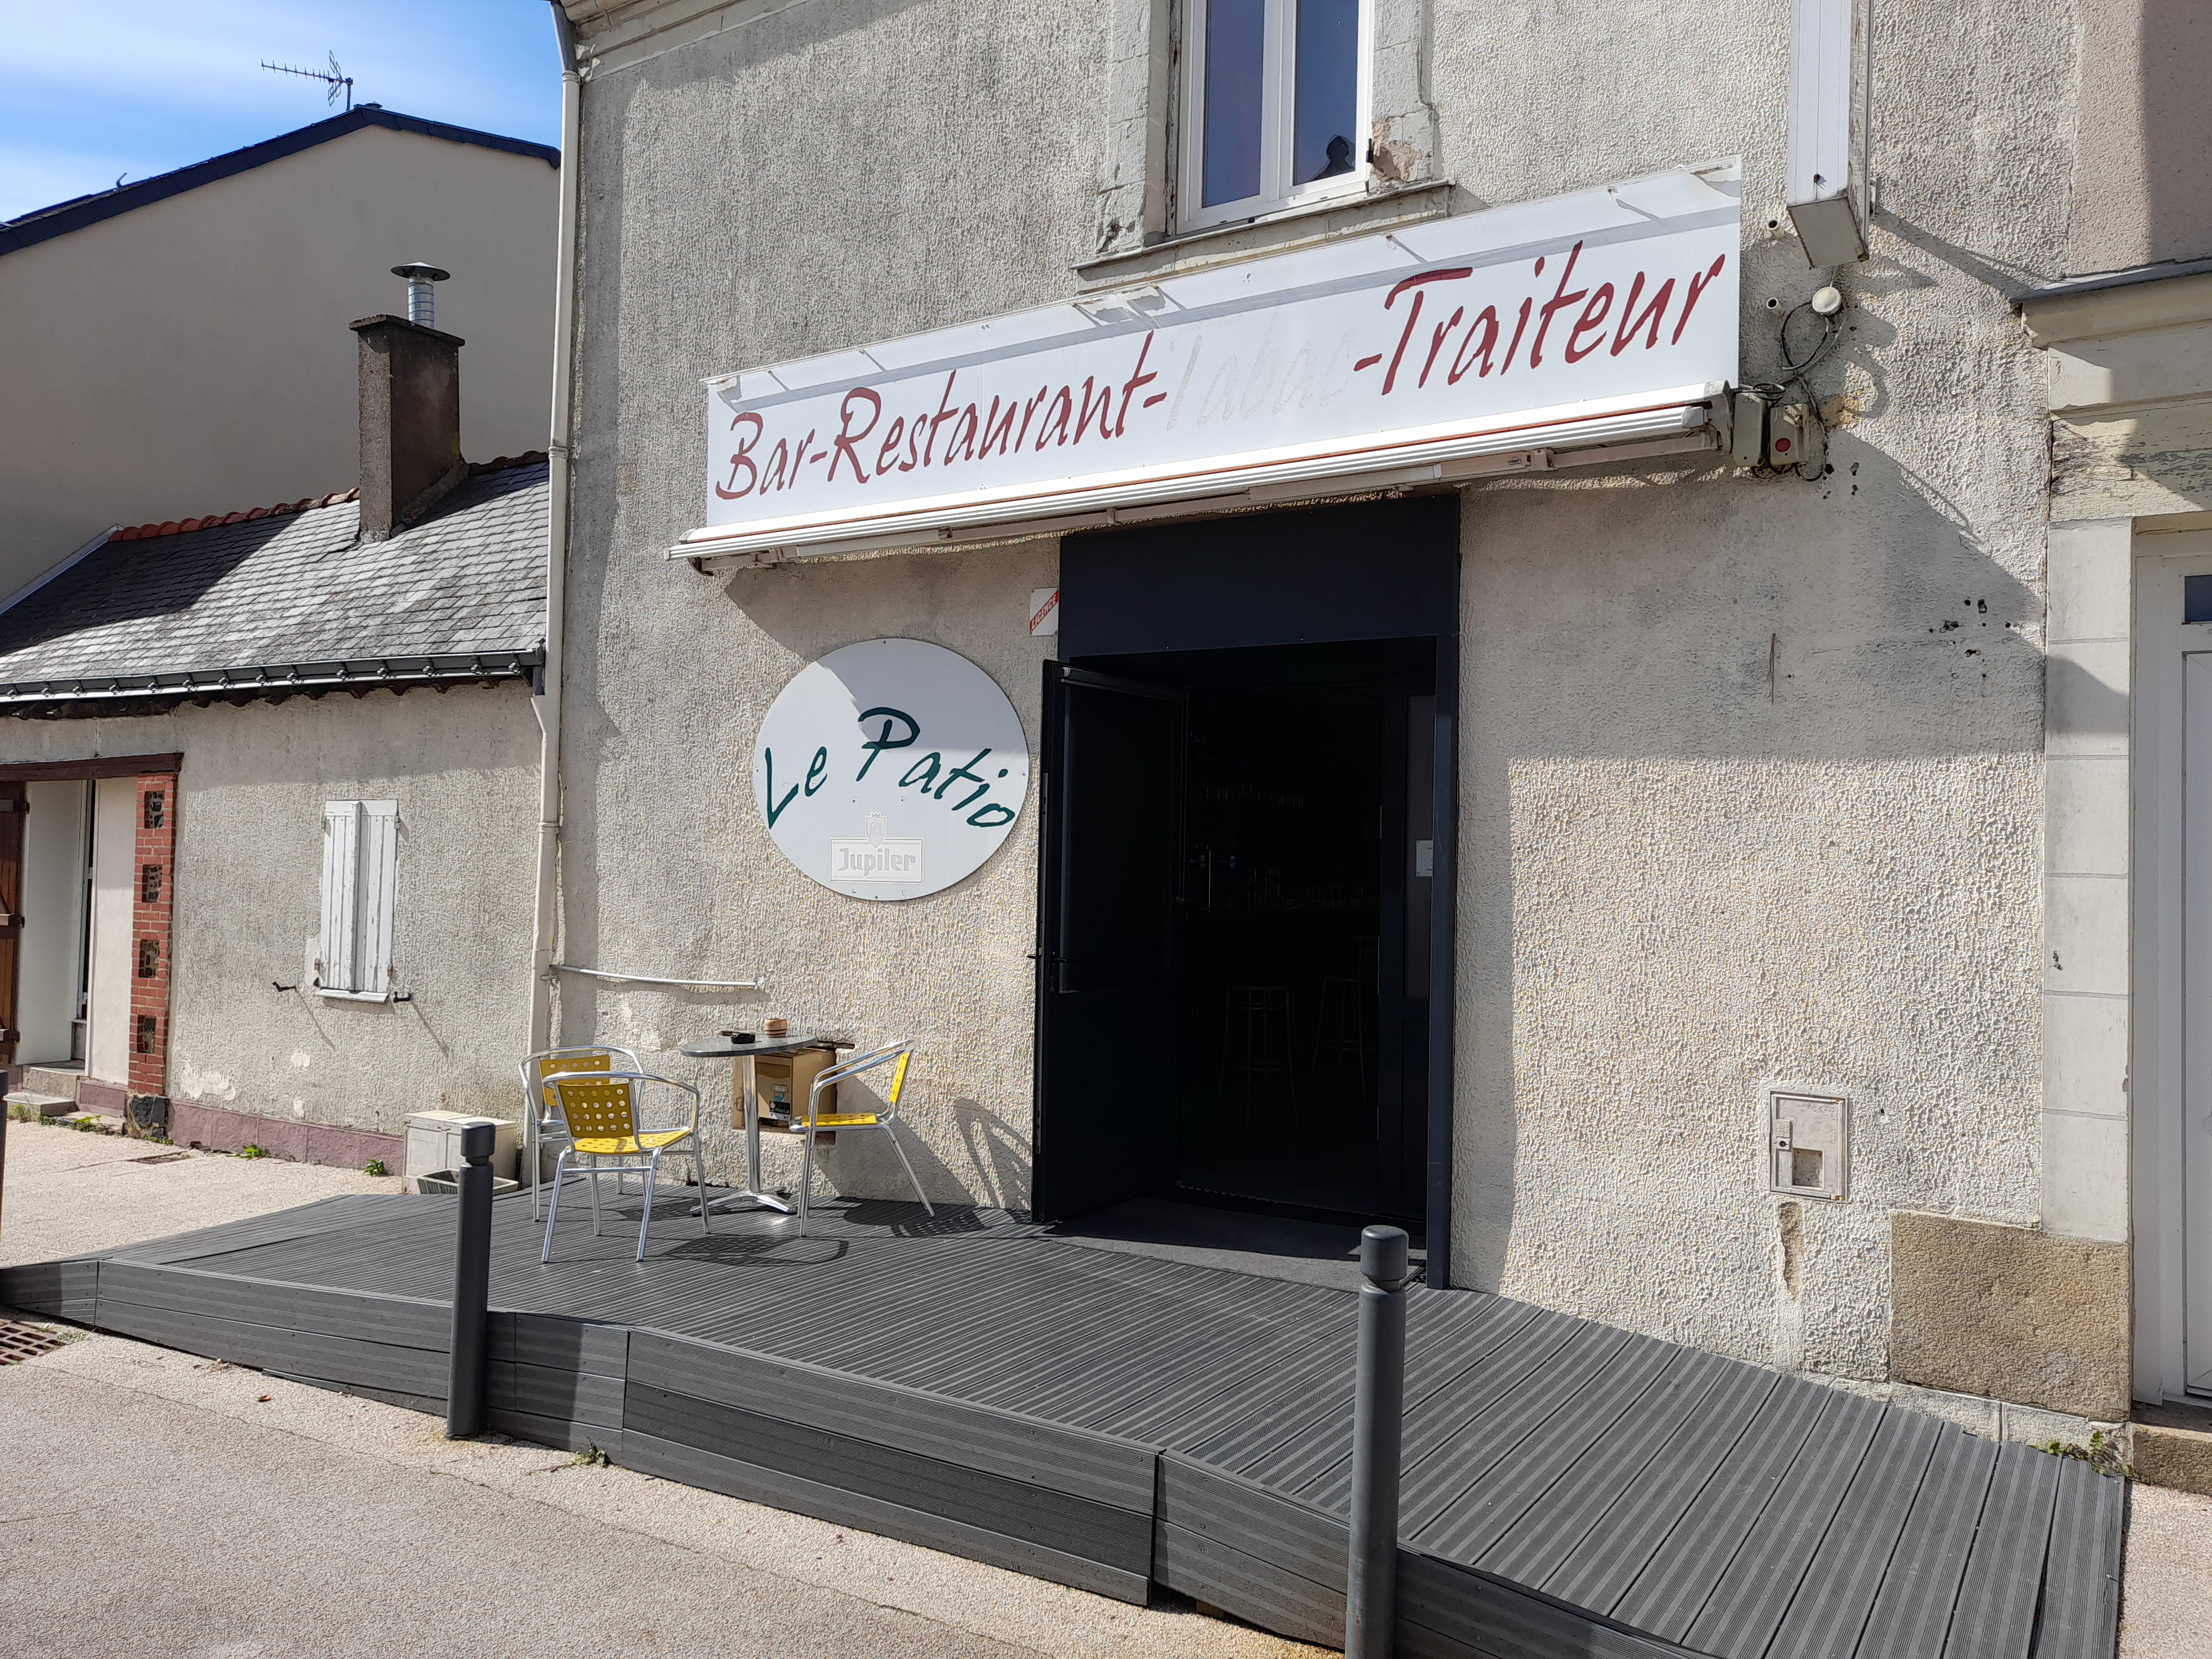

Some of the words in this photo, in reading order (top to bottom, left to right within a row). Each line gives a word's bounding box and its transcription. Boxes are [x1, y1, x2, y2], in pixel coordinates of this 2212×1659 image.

[1031, 594, 1057, 630] LICENCE
[765, 747, 827, 829] Le
[857, 707, 1015, 827] Patio
[837, 848, 916, 877] Jupiler
